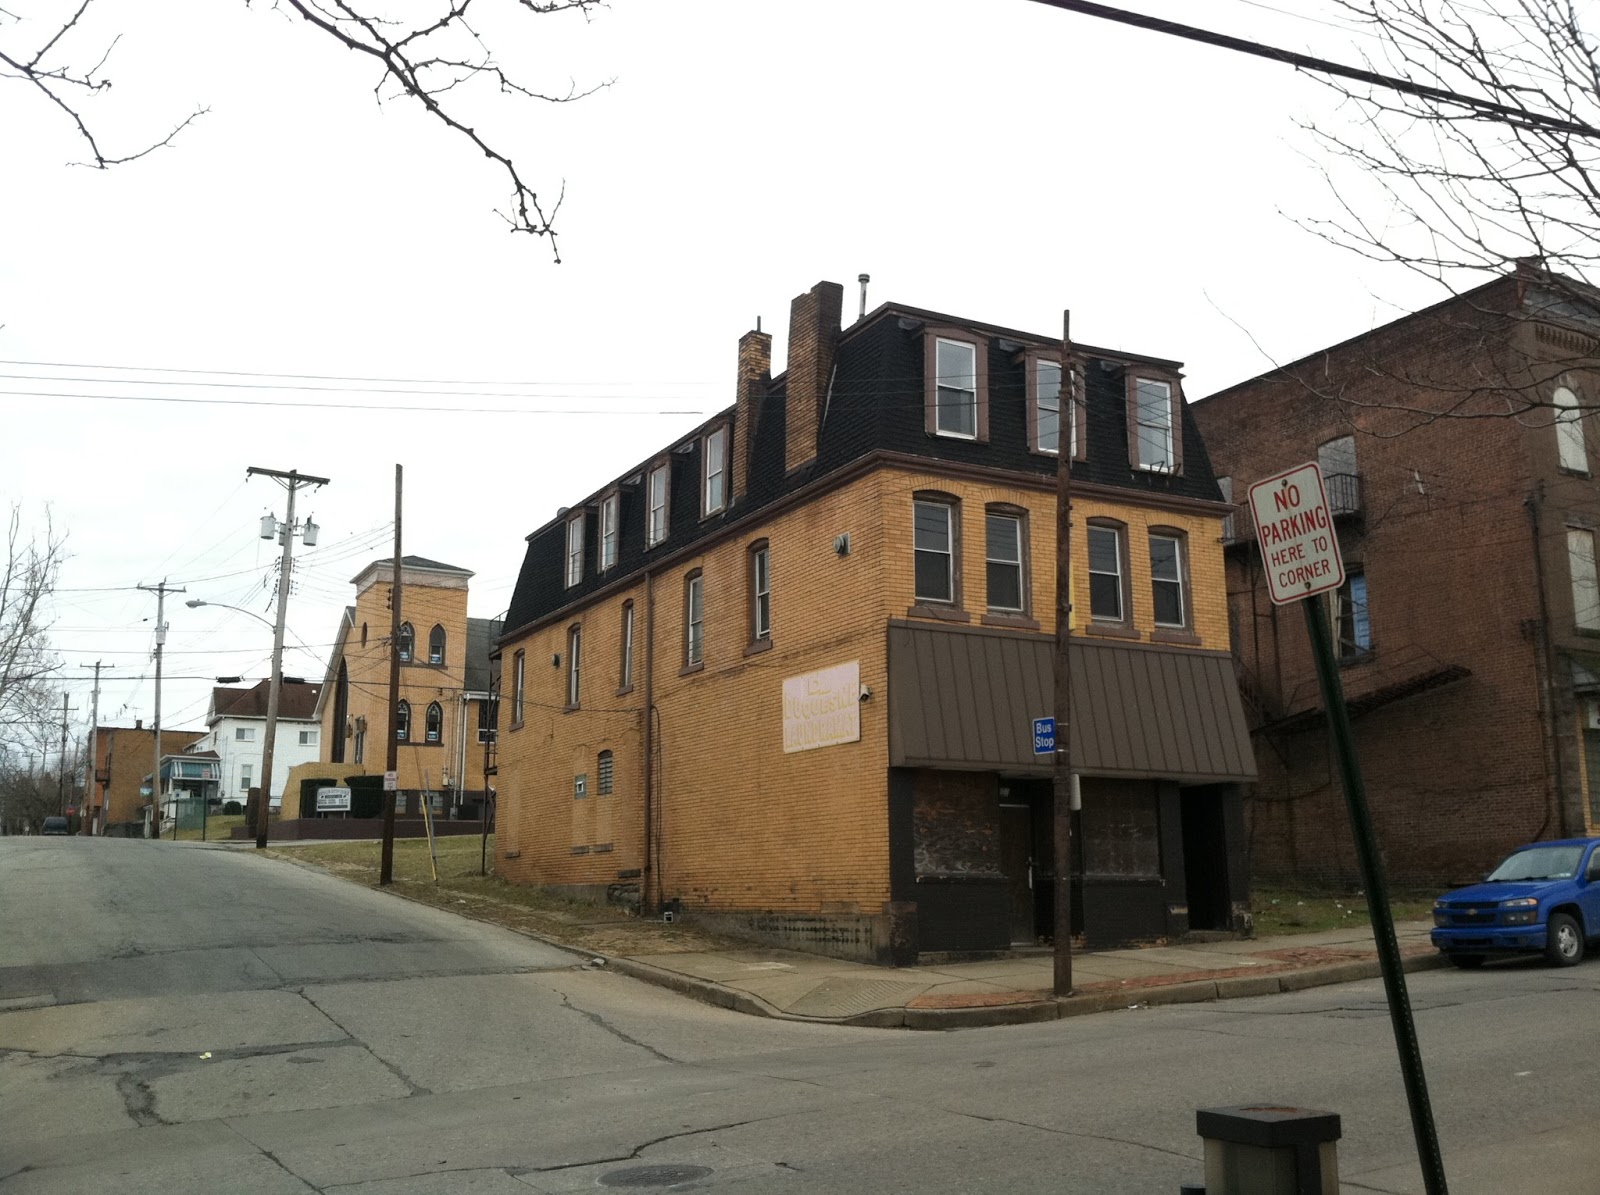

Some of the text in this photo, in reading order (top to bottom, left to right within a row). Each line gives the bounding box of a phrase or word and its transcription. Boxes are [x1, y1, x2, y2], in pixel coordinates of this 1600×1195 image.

[1273, 484, 1301, 513] NO
[1261, 505, 1327, 548] PARKING
[1270, 536, 1328, 568] HERE TO
[1278, 558, 1331, 588] CORNER
[1035, 736, 1054, 749] Stop
[1036, 722, 1052, 734] Bus
